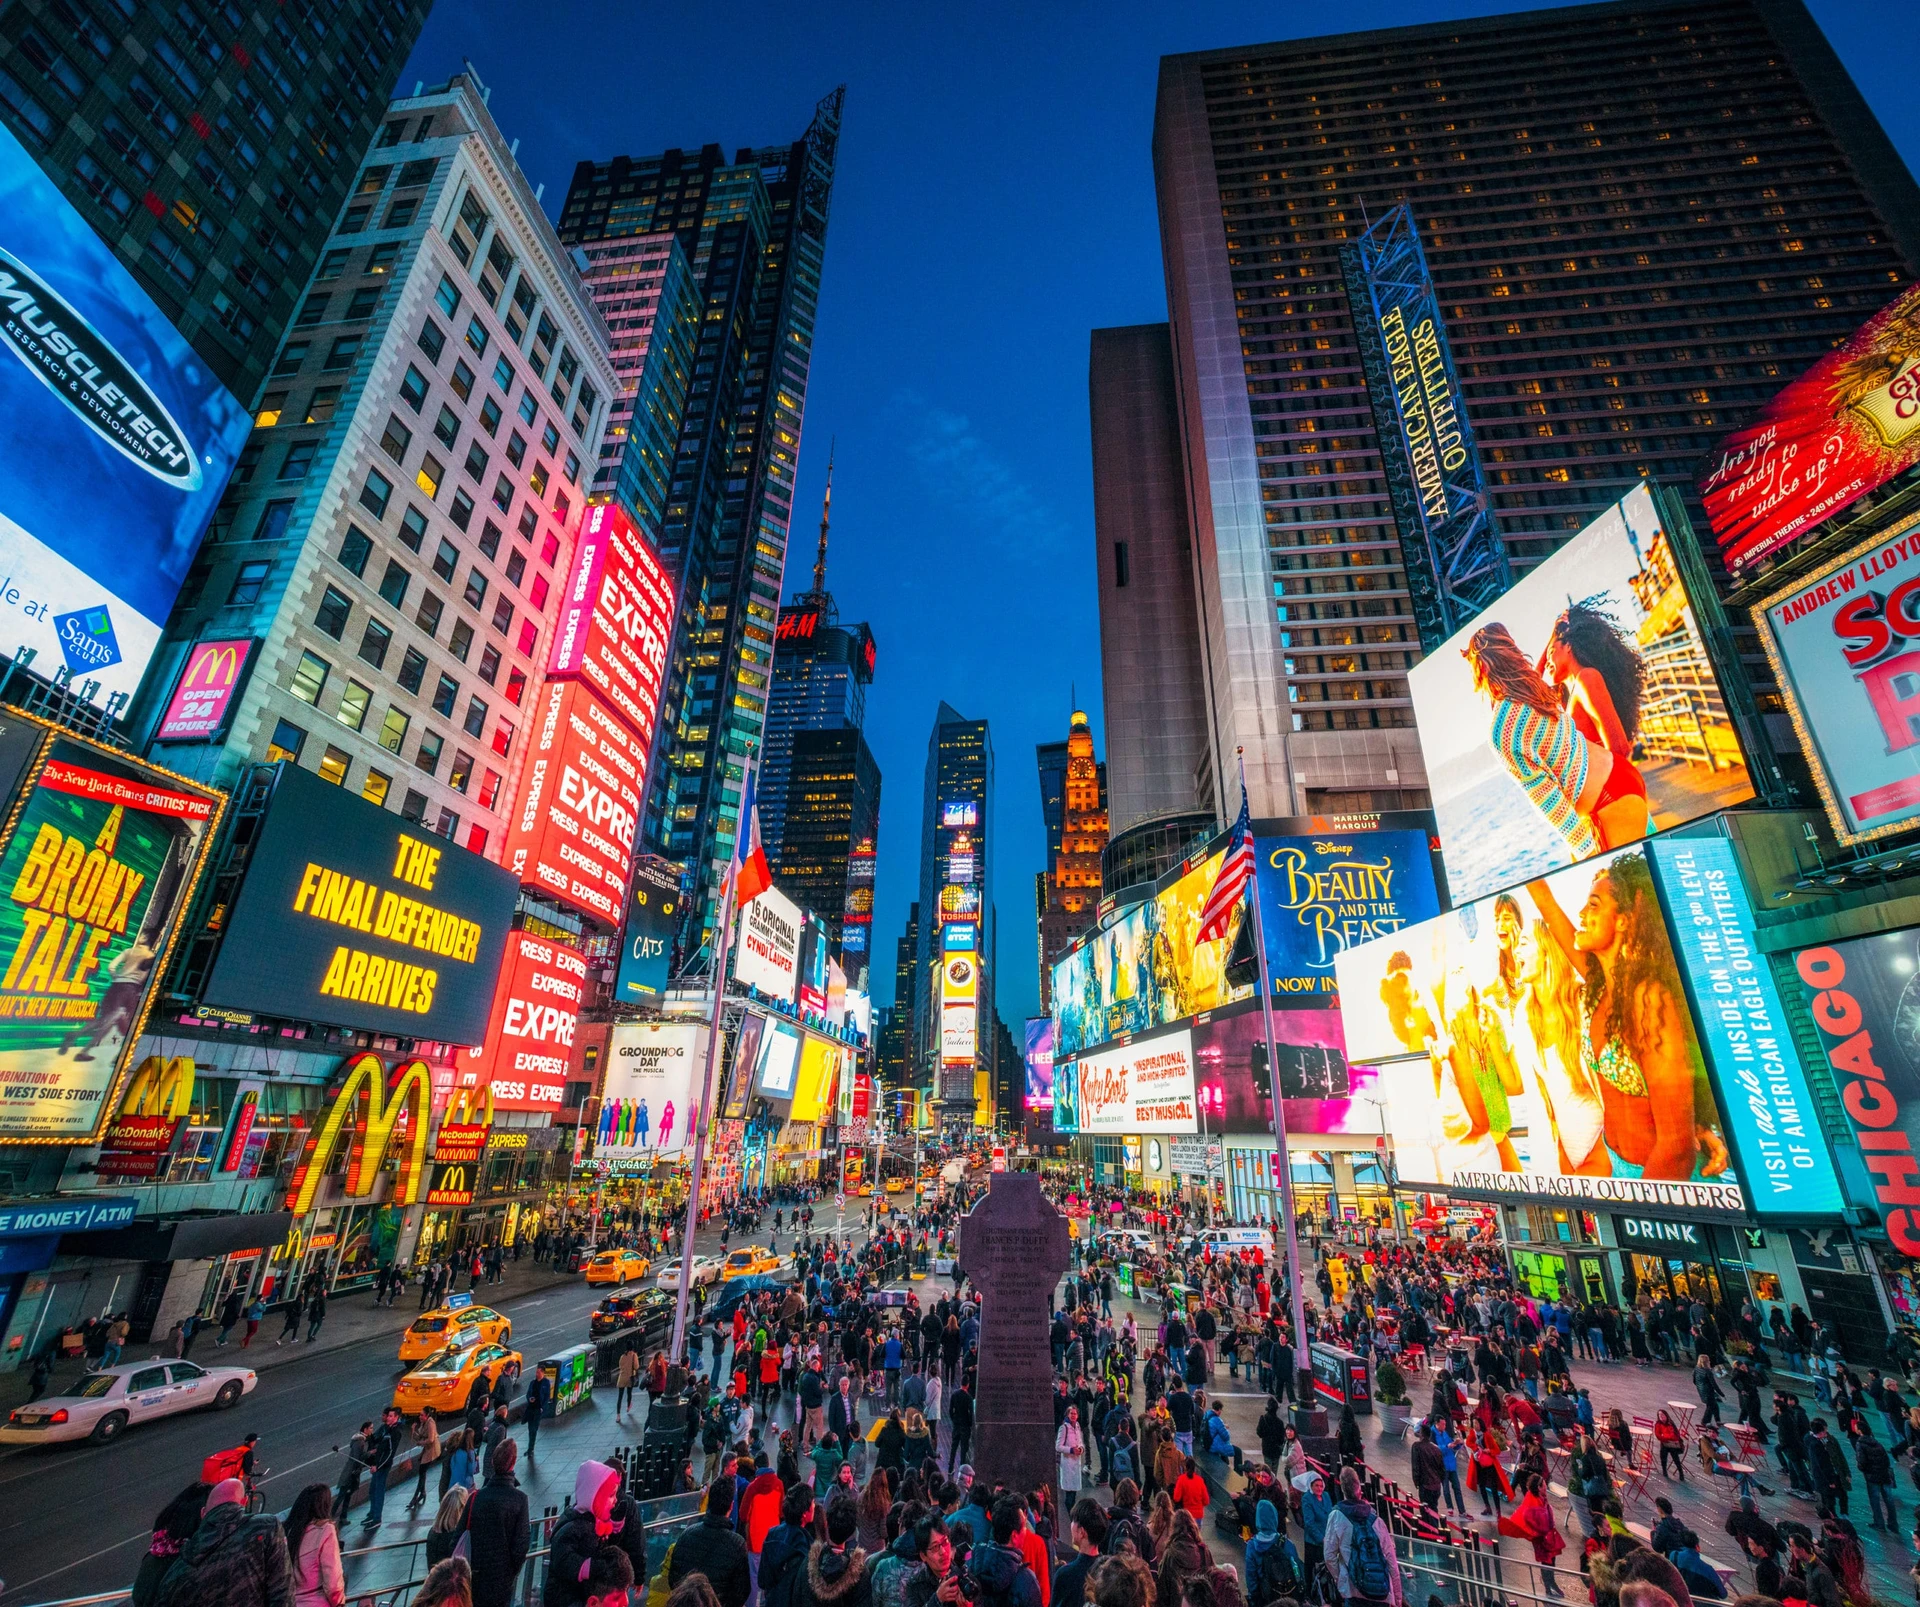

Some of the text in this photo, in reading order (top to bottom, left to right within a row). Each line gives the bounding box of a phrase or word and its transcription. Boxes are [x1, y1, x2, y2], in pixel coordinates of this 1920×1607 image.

[0, 271, 186, 468] MUSCLETECH
[6, 320, 152, 460] RESEARCH & DEVELOPMENT
[1412, 318, 1467, 472] OUTFITTERS
[1381, 305, 1449, 517] AMERICAN EAGLE
[1705, 426, 1777, 494] Are you
[1728, 441, 1798, 502] ready to
[1806, 436, 1843, 499] up?
[1602, 502, 1644, 543] REAL
[1744, 536, 1776, 561] IMPERIAL
[1775, 514, 1807, 541] THEATRE
[1810, 503, 1826, 517] 249
[1850, 478, 1866, 491] ST.
[573, 545, 596, 602] EXPRESS
[625, 529, 659, 580] EXPRESS
[617, 568, 651, 617] EXPRESS
[636, 567, 667, 614] EXPRESS
[24, 597, 49, 623] at
[775, 612, 818, 640] H&M
[60, 617, 113, 664] Sam's
[557, 609, 580, 670] EXPRESS
[601, 646, 637, 691] EXPRESS
[620, 641, 654, 685] EXPRESS
[179, 701, 213, 719] 24
[182, 689, 222, 701] OPEN
[611, 684, 646, 727] EXPRESS
[163, 719, 217, 733] HOURS
[540, 683, 565, 750] EXPRESS
[589, 703, 627, 747] EXPRESS
[579, 751, 619, 792] EXPRESS
[600, 741, 636, 779] EXPRESS
[43, 765, 64, 780] The
[63, 770, 86, 787] New
[87, 777, 114, 796] York
[114, 784, 145, 802] Times
[188, 800, 211, 815] PICK
[521, 760, 548, 832] EXPRESS
[95, 803, 124, 852] A
[1333, 814, 1382, 823] MARRIOTT
[1334, 822, 1378, 830] MARQUIS
[392, 833, 441, 891] THE
[560, 843, 603, 881] EXPRESS
[582, 828, 621, 864] EXPRESS
[1189, 845, 1209, 863] MARRIOTT
[1190, 854, 1208, 869] MARQUIS
[10, 821, 145, 934] BRONX
[645, 866, 675, 884] IT'S BACK AND
[655, 878, 667, 887] THAN
[1269, 847, 1394, 910] BEAUTY
[293, 862, 483, 965] FINAL DEFENDER
[571, 881, 611, 915] EXPRESS
[942, 913, 979, 921] TOSHIBA
[1338, 902, 1399, 917] AND THE
[751, 897, 795, 944] 16 ORIGINAL
[2, 907, 111, 996] TALE
[633, 936, 664, 959] CATS
[746, 934, 793, 974] CYNDI LAUPER
[320, 946, 438, 1015] ARRIVES
[531, 972, 576, 1001] EXPRESS
[1275, 977, 1316, 993] NOW
[24, 996, 98, 1019] NEW HIT MUSICAL
[1674, 850, 1793, 1193] VISIT aerie INSIDE ON THE 3RD LEVEL
[1704, 869, 1815, 1169] OF AMERICAN EAGLE OUTFITTERS
[514, 1052, 563, 1075] EXPRESS
[619, 1047, 684, 1057] GROUNDHOG
[640, 1057, 660, 1067] DAY
[3, 1085, 65, 1100] WEST SIDE
[48, 1073, 62, 1085] OF
[1079, 1062, 1129, 1129] Kinky Boots
[1137, 1072, 1147, 1084] AND
[242, 1107, 253, 1130] OPEN
[1136, 1101, 1193, 1122] BEST MUSICAL
[1796, 946, 1920, 1258] CHICAGO
[107, 1126, 171, 1140] McDonald's
[113, 1139, 157, 1147] Restaurant
[438, 1130, 485, 1139] McDonald's
[487, 1133, 528, 1148] EXPRESS
[98, 1161, 118, 1169] OPEN
[119, 1161, 129, 1169] 24
[231, 1138, 243, 1167] HOURS
[1452, 1171, 1743, 1210] AMERICAN EAGLE OUTFITTERS
[468, 1212, 487, 1221] EXPRESS
[1625, 1218, 1697, 1244] DRINK
[981, 1236, 1050, 1245] FRANCIS DUFFY
